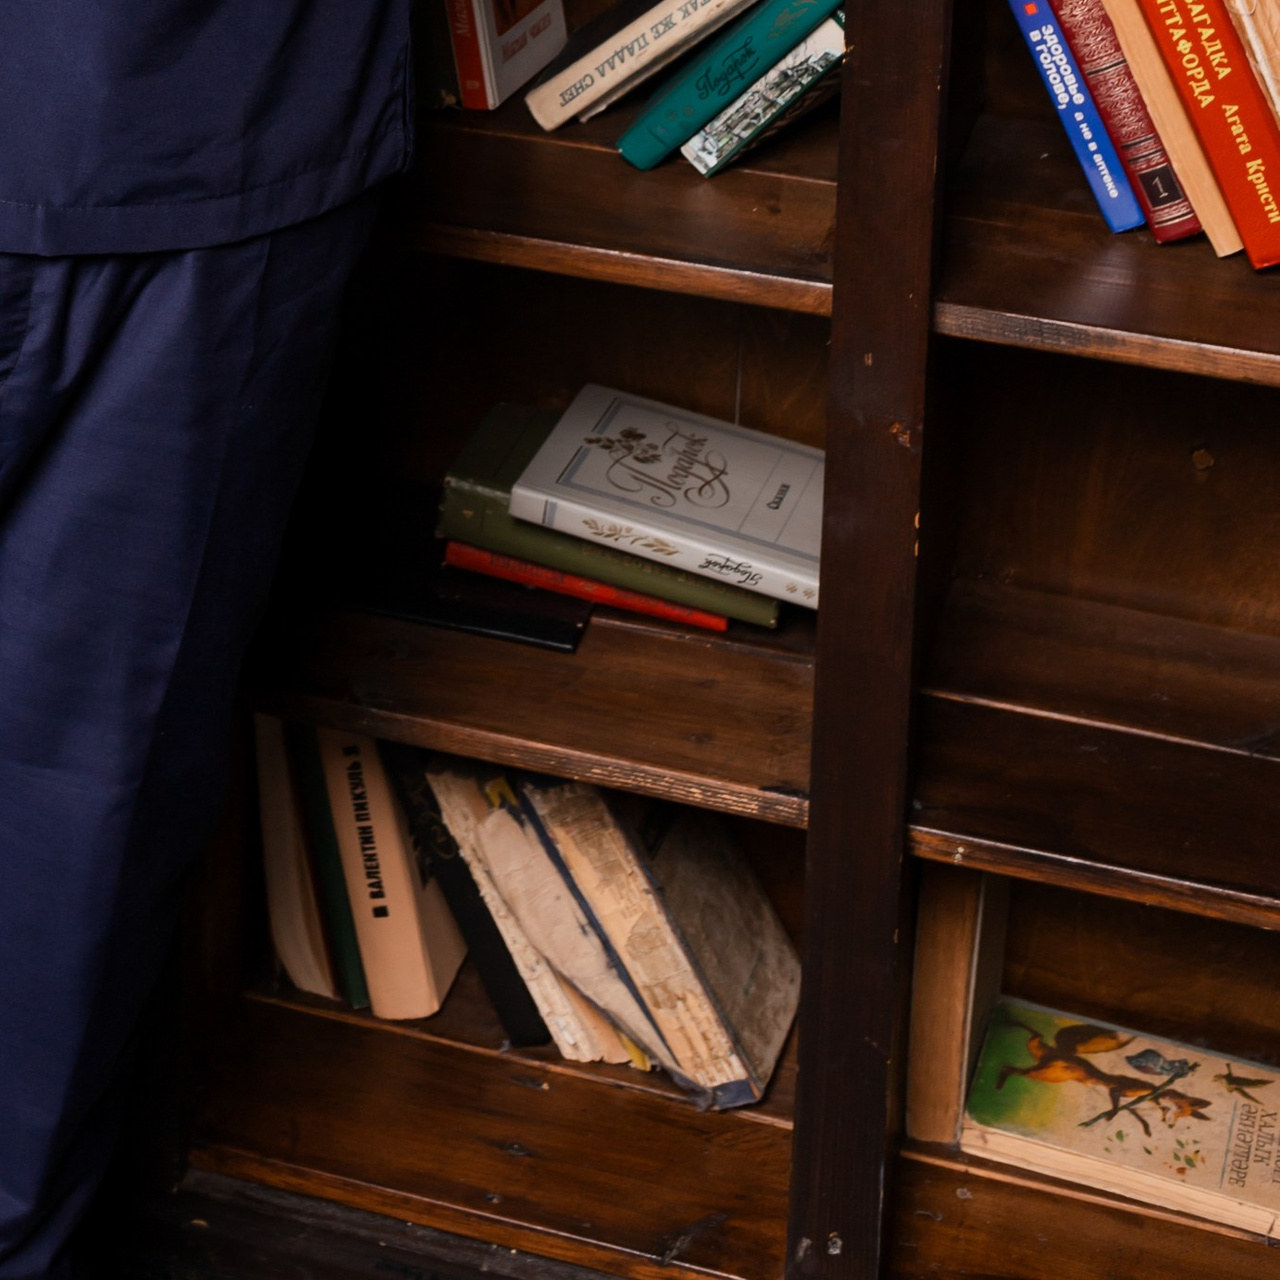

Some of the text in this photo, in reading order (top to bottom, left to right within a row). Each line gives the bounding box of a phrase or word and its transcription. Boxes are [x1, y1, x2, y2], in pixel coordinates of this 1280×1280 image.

[650, 15, 678, 41] ЖЕ
[595, 32, 651, 78] ПАДАЛ
[694, 36, 760, 101] Подарок
[558, 73, 596, 108] СНЕГ
[1092, 152, 1120, 200] аптеке
[1221, 102, 1280, 225] Агата Кристи
[697, 552, 764, 587] Подарок
[345, 759, 386, 900] ВАЛЕНТИН ПИКУЛЬ
